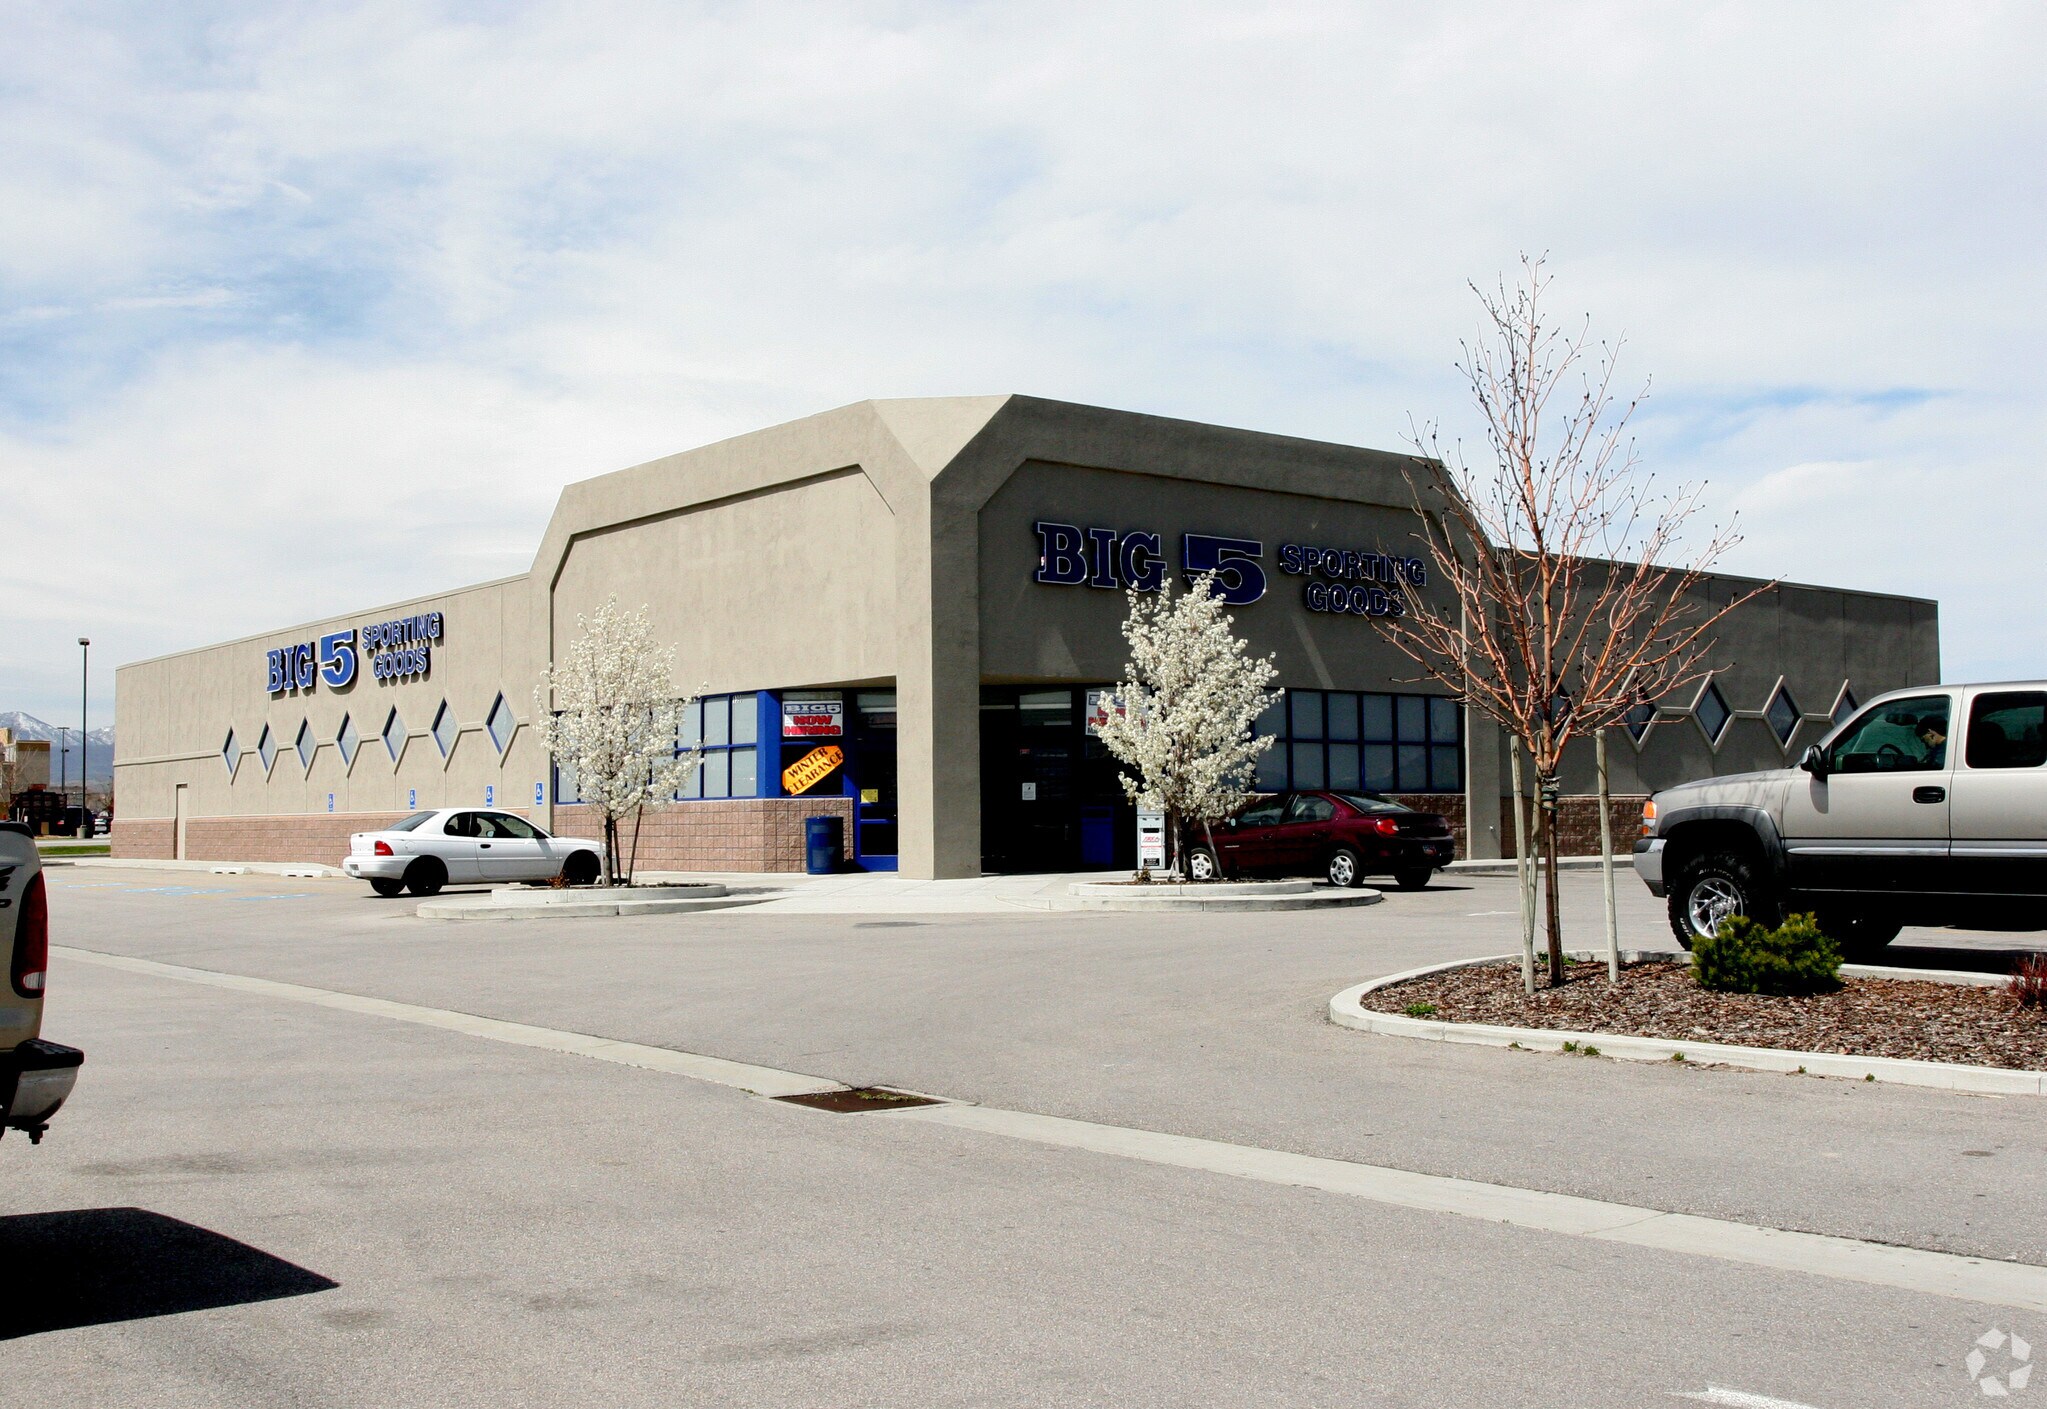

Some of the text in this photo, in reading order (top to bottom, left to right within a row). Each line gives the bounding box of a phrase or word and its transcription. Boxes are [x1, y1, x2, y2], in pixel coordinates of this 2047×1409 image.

[1035, 521, 1267, 605] BIG 5
[1281, 543, 1427, 587] SPORTING
[1305, 581, 1406, 617] GOODS
[361, 611, 441, 650] SPORTING
[266, 628, 355, 693] BIG 5
[372, 646, 428, 680] GOODS
[793, 715, 833, 725] NOW
[787, 749, 843, 795] CLEARANCE
[788, 748, 828, 778] WINTER
